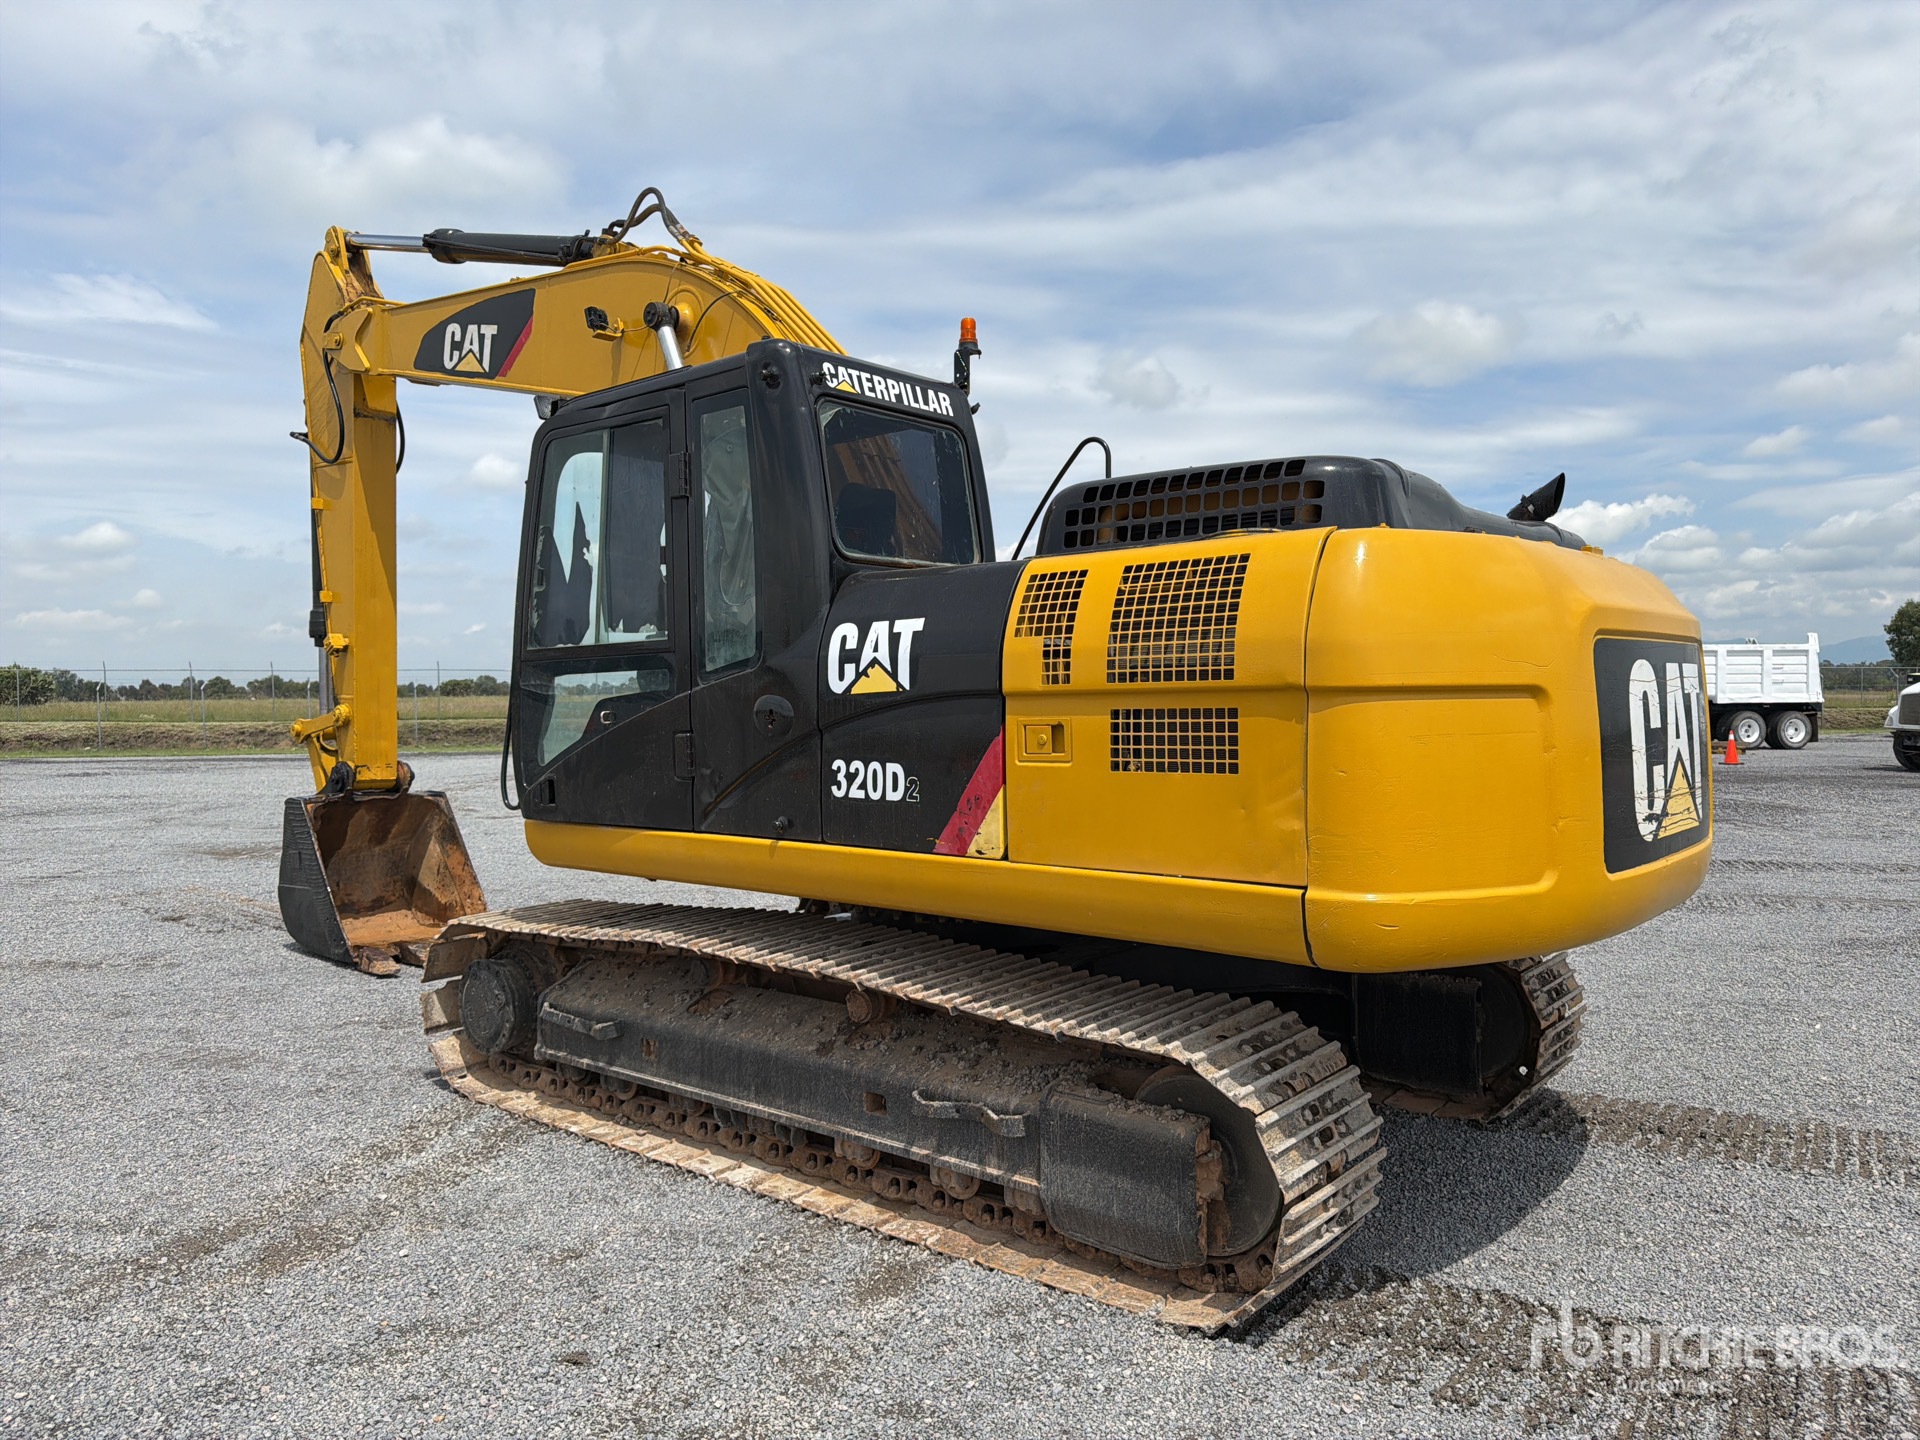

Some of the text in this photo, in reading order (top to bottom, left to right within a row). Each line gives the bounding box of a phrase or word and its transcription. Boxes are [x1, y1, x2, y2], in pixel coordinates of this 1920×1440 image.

[443, 322, 498, 373] CAT
[822, 361, 954, 417] CATERPILLAR
[827, 617, 926, 695] CAT
[1629, 658, 1703, 842] CAT
